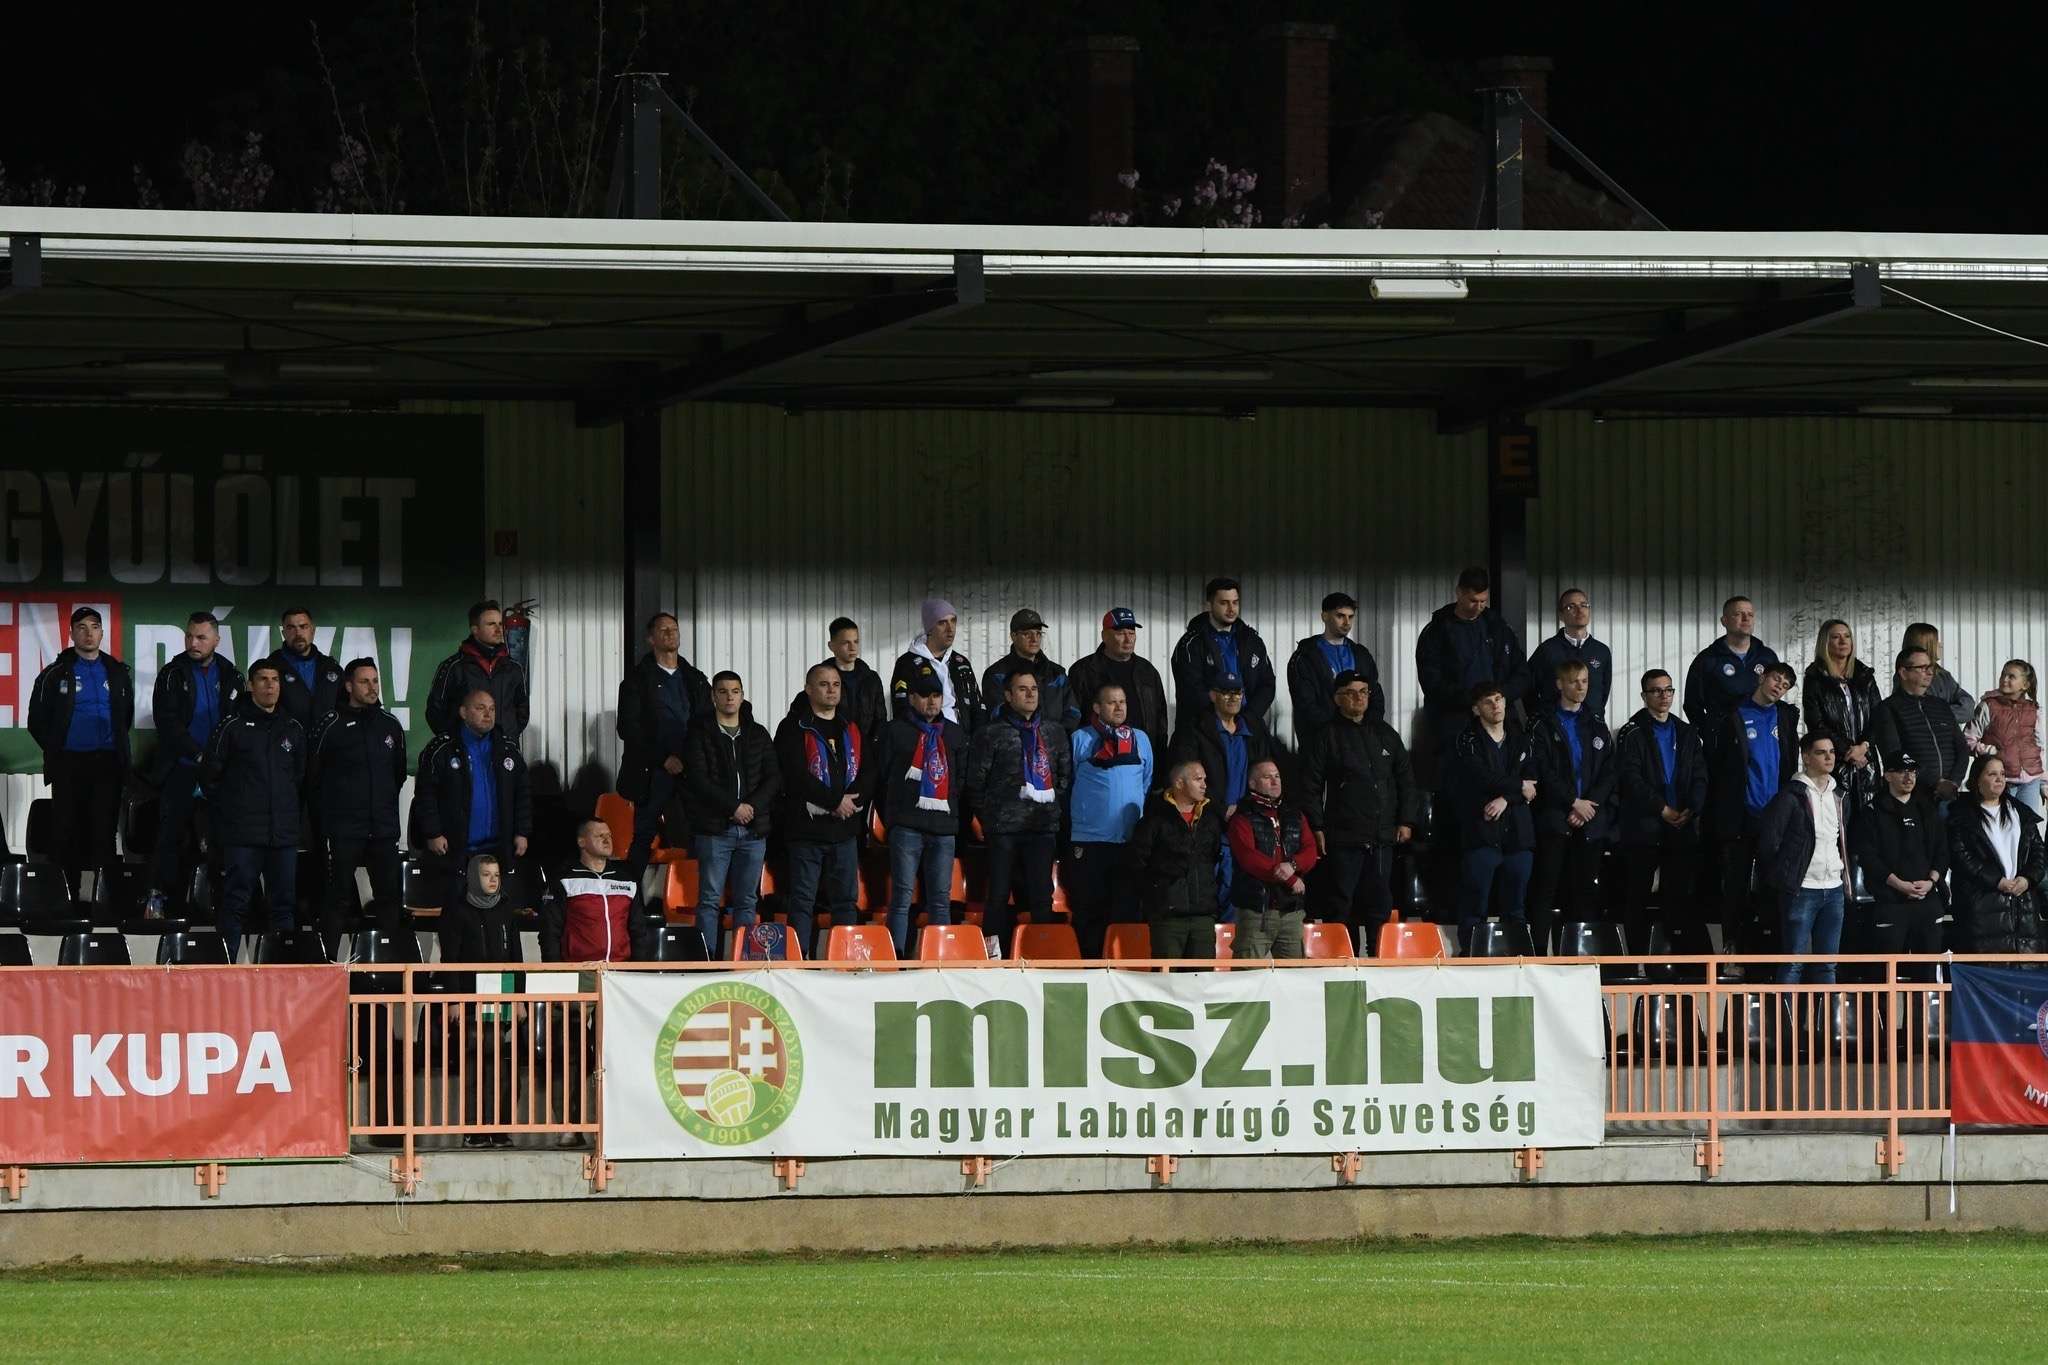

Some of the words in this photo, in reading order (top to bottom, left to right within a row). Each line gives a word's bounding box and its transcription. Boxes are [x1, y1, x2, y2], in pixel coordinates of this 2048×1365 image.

[873, 980, 1536, 1090] mlsz.hu
[0, 1035, 51, 1098] R
[73, 1031, 292, 1097] KUPA
[707, 1126, 752, 1144] 1901
[873, 1102, 1035, 1143] Magyar
[1057, 1100, 1290, 1142] Labdarúgó
[1313, 1095, 1536, 1136] Szövetség
